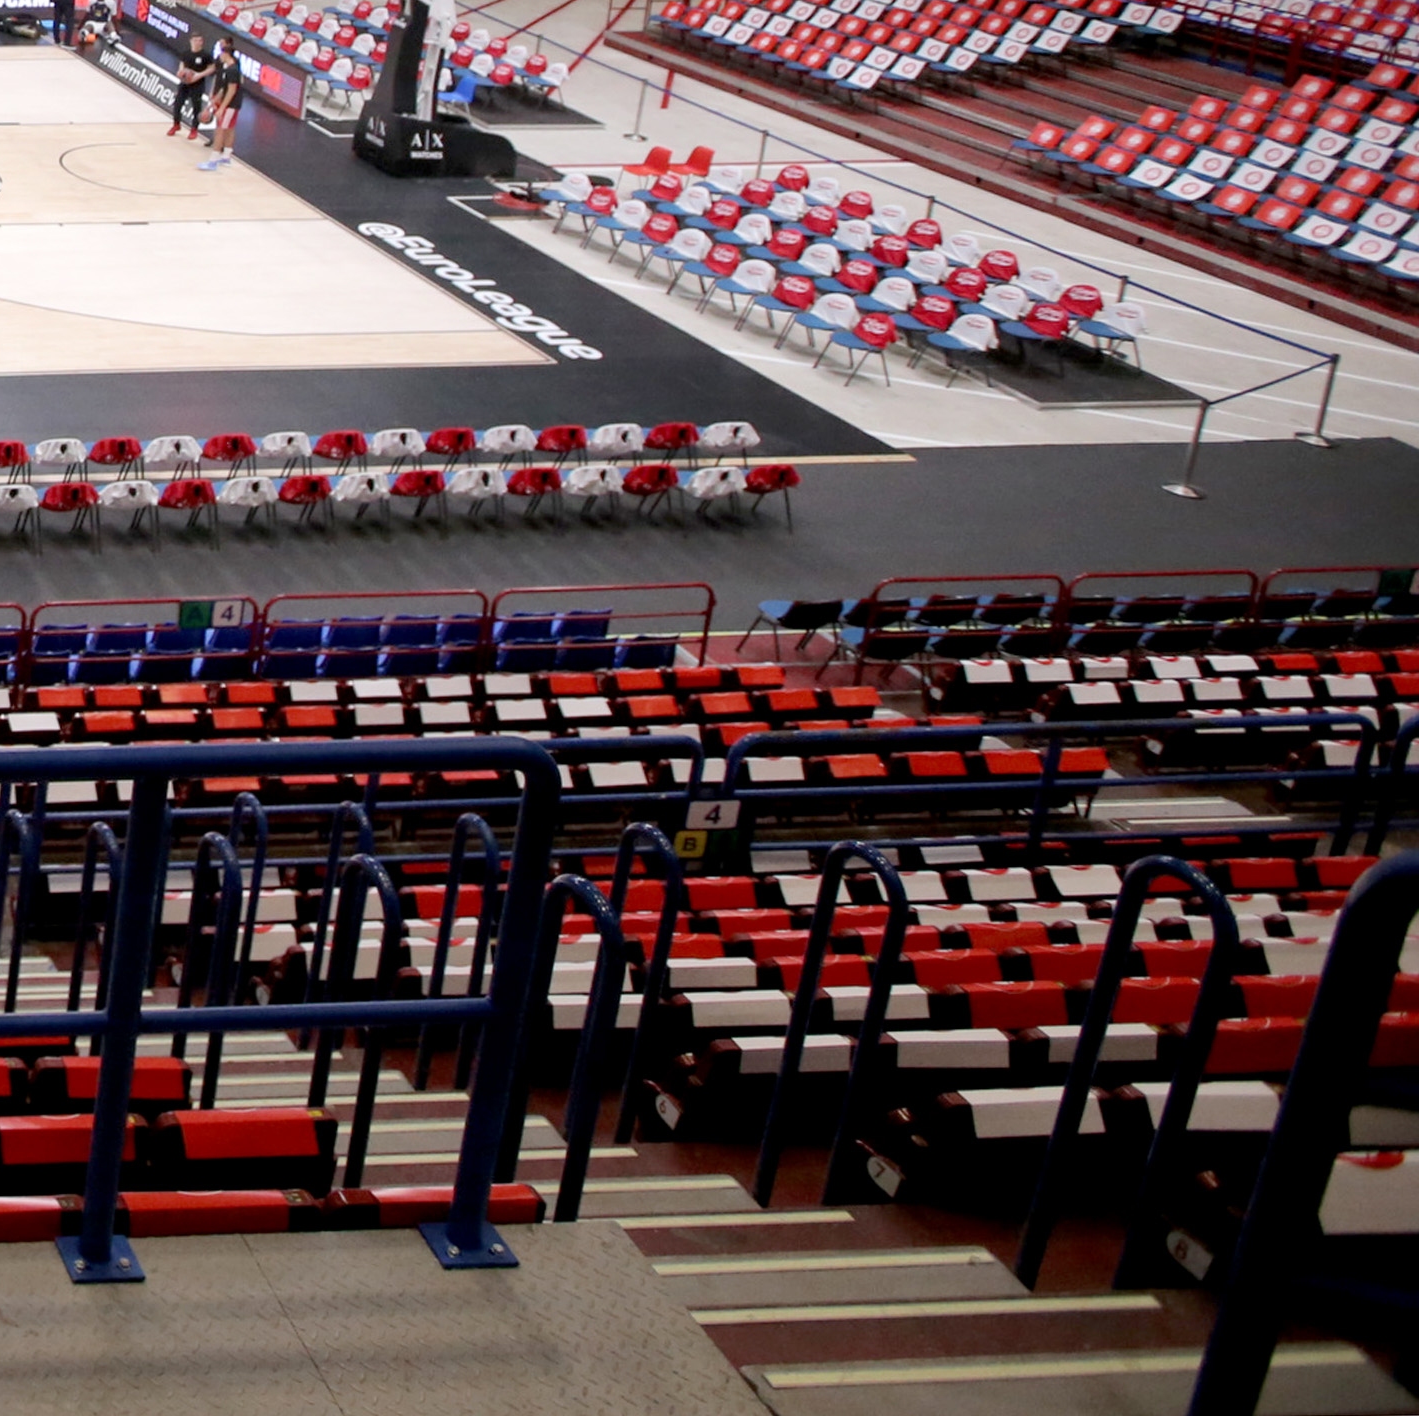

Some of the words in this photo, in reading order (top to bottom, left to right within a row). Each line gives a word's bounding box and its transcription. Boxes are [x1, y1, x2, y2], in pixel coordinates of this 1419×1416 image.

[357, 222, 604, 361] @EuroLeague
[220, 604, 235, 622] 4
[704, 803, 722, 825] 4
[682, 837, 698, 852] B
